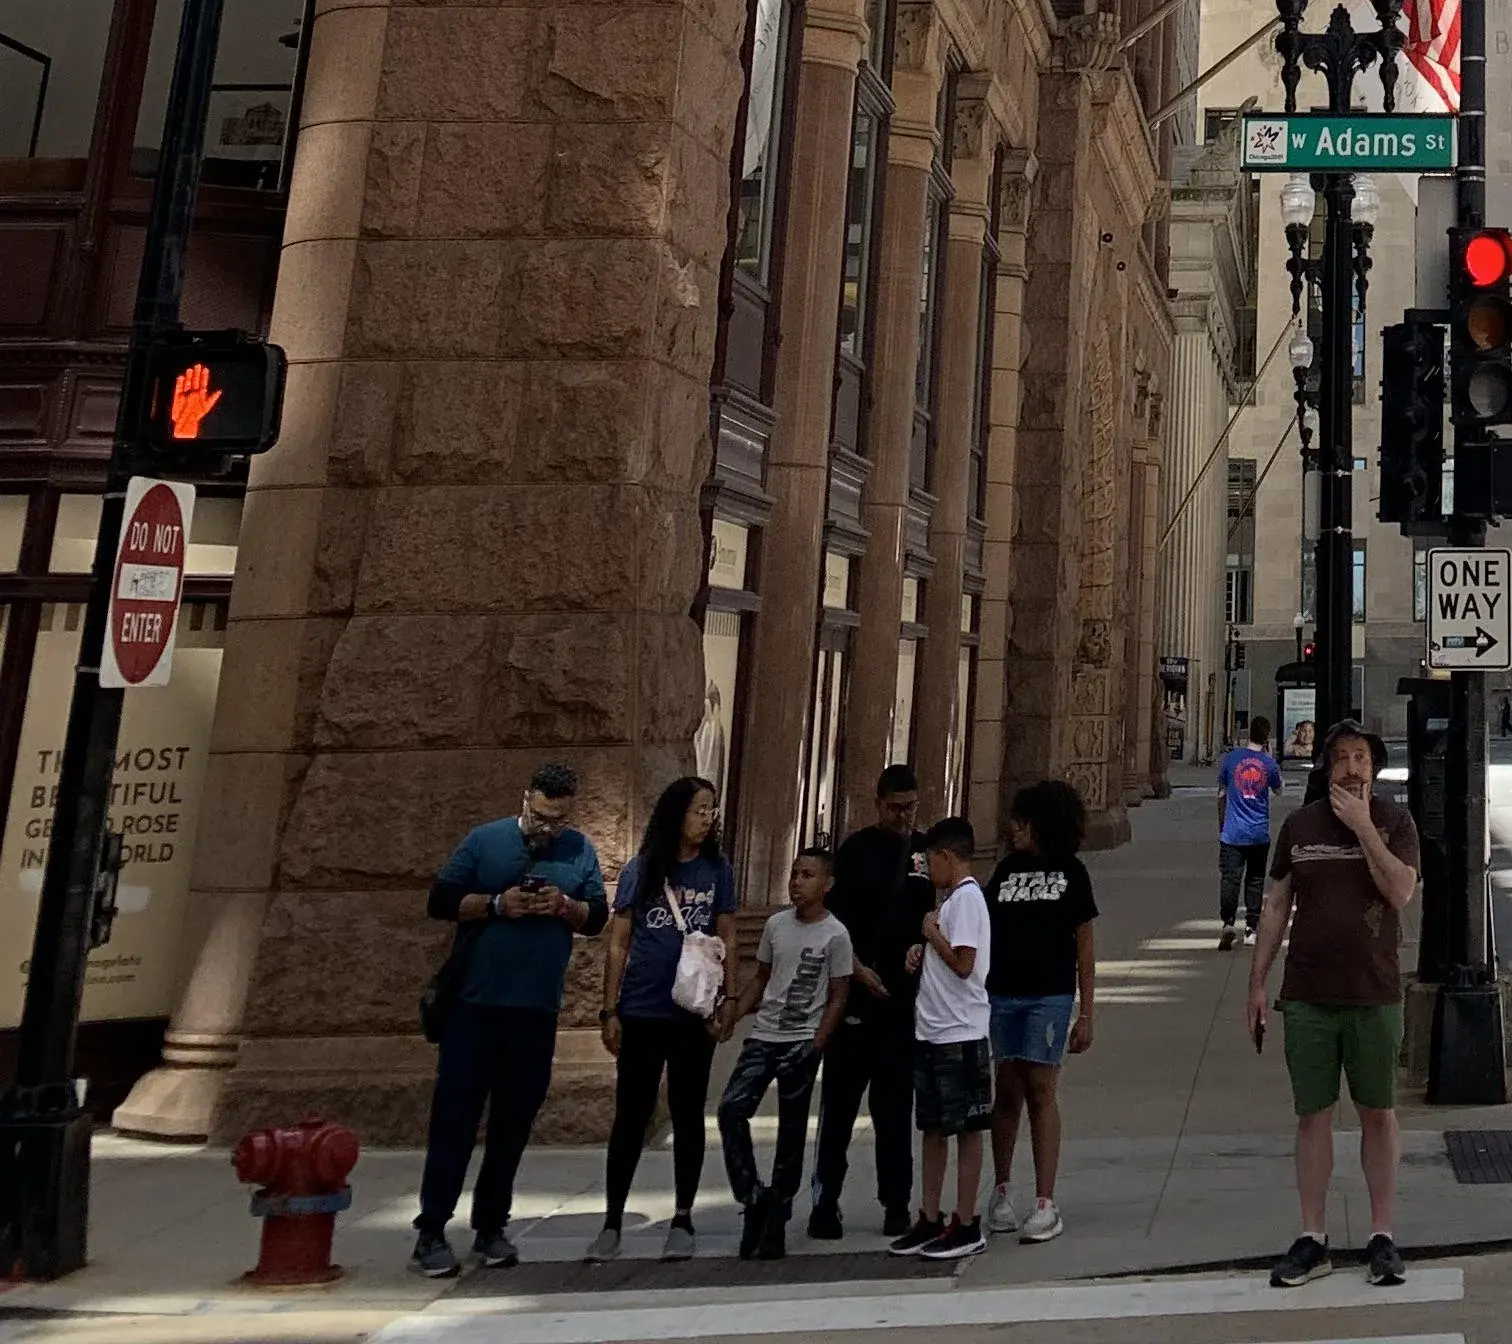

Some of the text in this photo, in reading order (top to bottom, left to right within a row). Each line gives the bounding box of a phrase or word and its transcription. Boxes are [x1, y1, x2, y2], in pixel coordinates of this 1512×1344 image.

[1292, 127, 1445, 157] W Adams St
[129, 522, 180, 555] DO NOT
[1440, 560, 1500, 587] ONE
[1438, 593, 1501, 620] WAY
[120, 612, 163, 644] ENTER
[122, 814, 180, 834] ROSE
[121, 843, 174, 863] ORLD
[997, 884, 1061, 902] WARS
[1000, 871, 1068, 892] STAR
[646, 906, 711, 931] Be Kind
